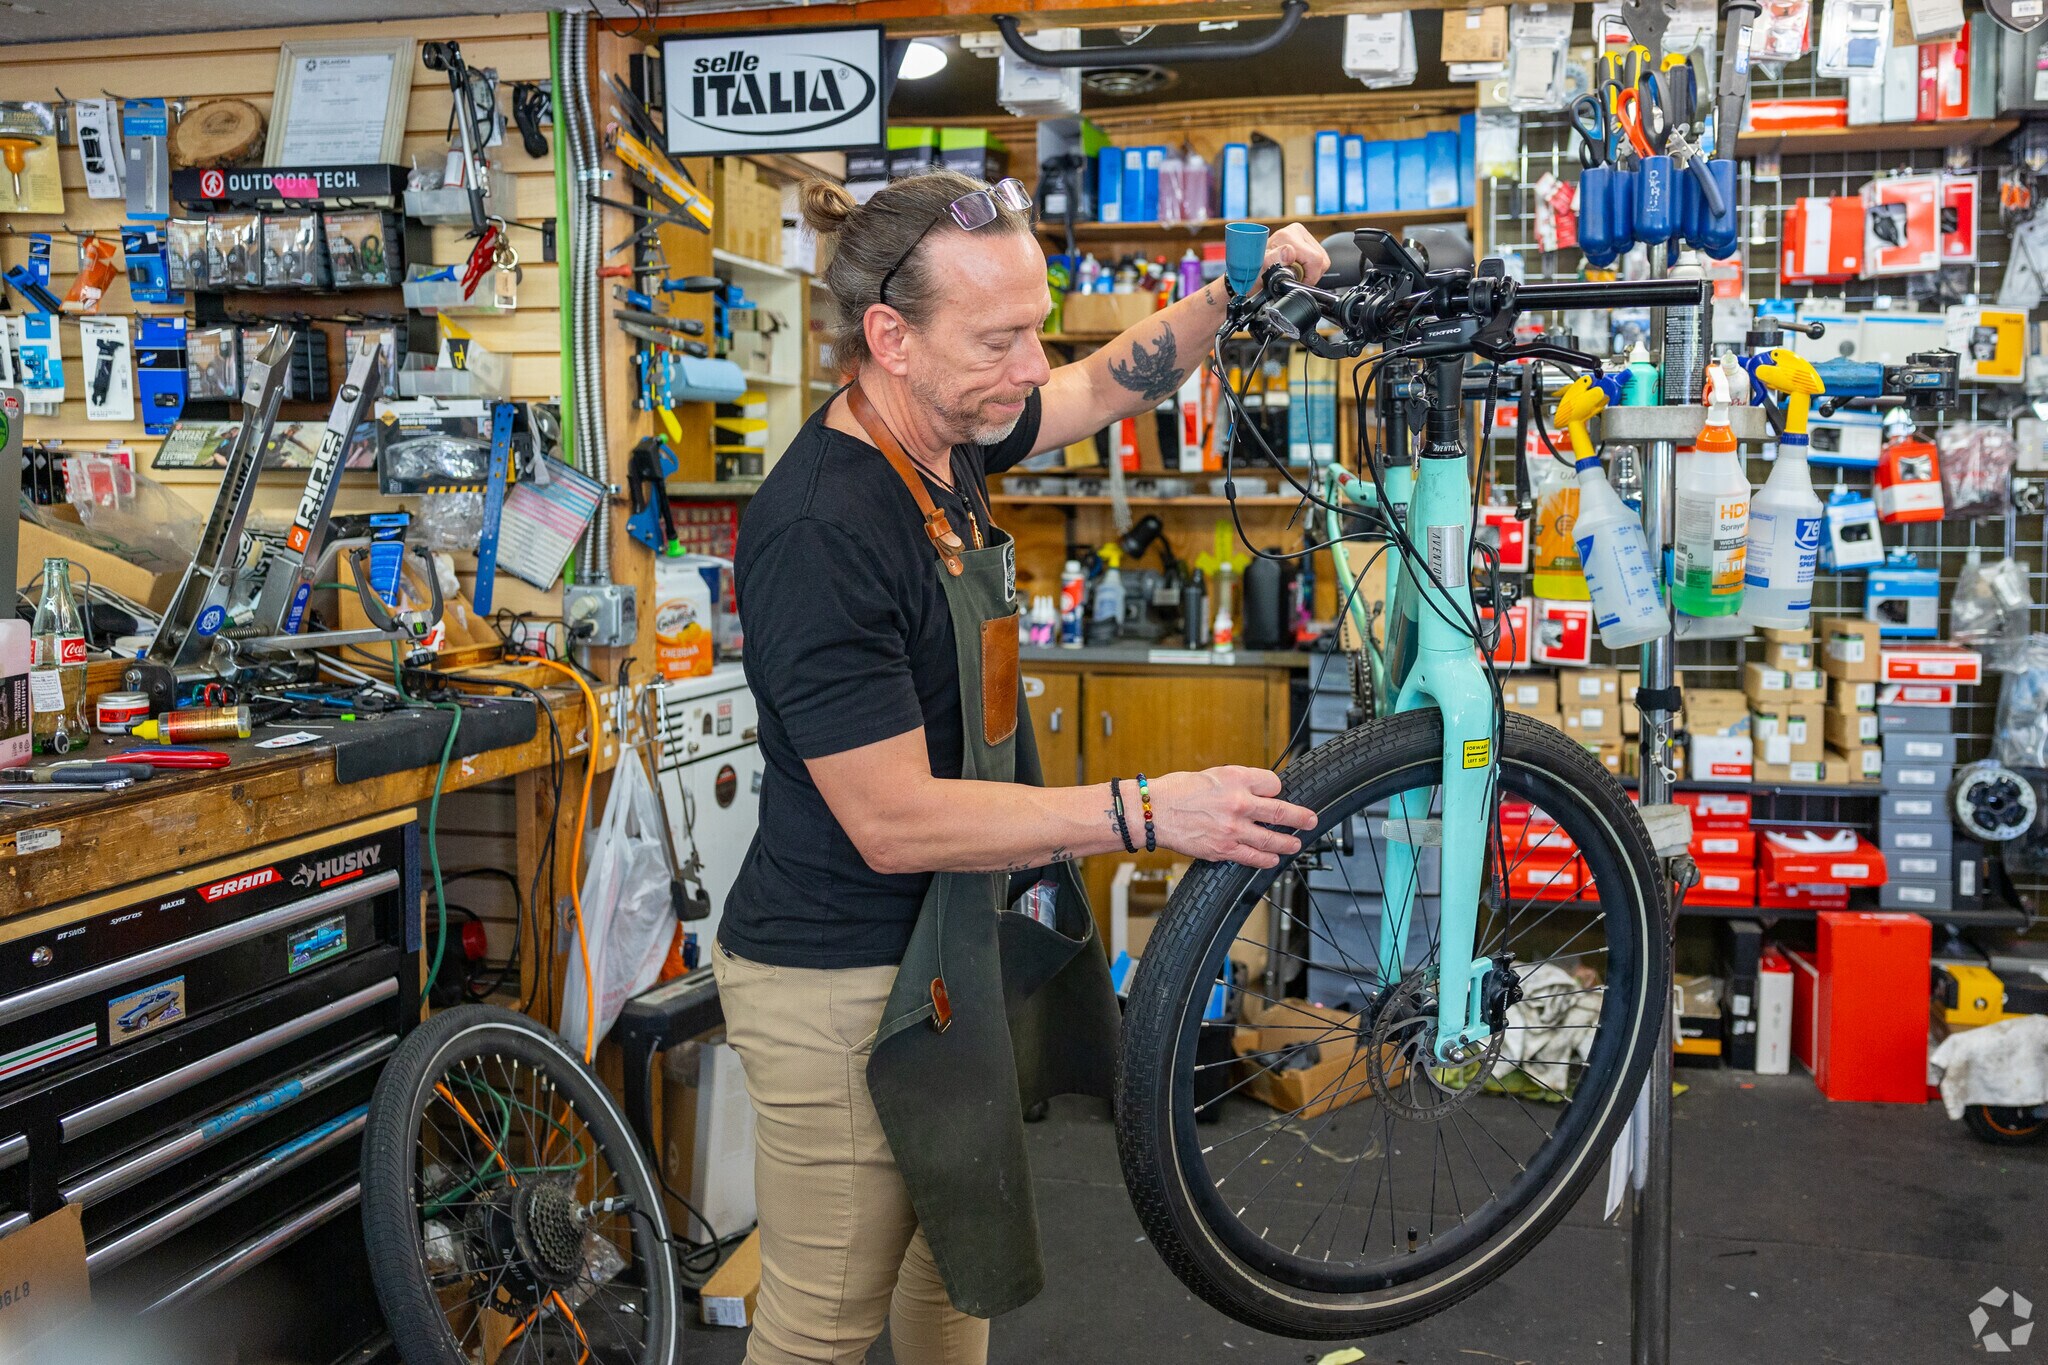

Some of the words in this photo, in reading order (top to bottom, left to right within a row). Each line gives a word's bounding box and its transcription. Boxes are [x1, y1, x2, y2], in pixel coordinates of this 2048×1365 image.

[693, 50, 760, 75] selle
[692, 68, 846, 118] ITALIA
[229, 172, 309, 191] OUTDOOR
[1428, 327, 1462, 337] TEKTRO
[1720, 522, 1745, 532] Sprayer
[208, 869, 273, 900] SRAM
[316, 844, 381, 882] HUSKY
[159, 897, 186, 912] MAXXIS
[68, 926, 86, 938] SWISS
